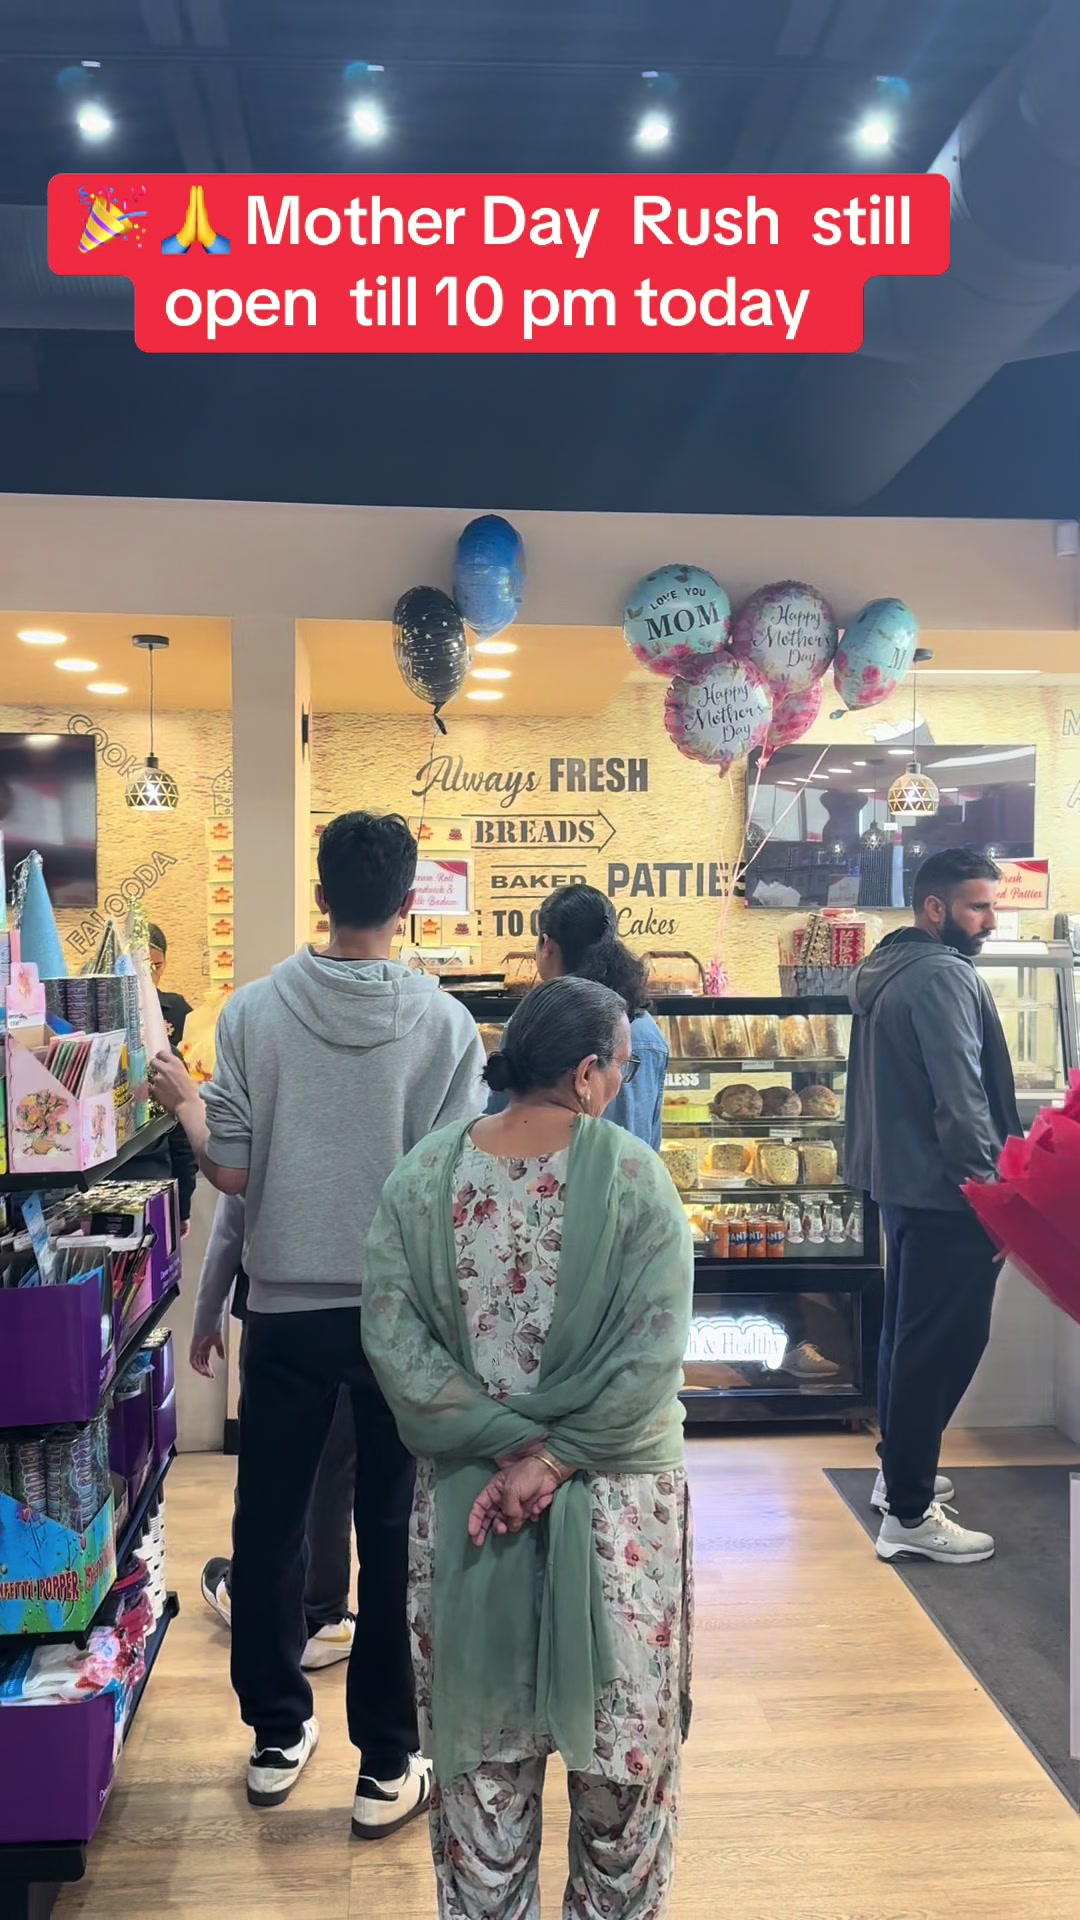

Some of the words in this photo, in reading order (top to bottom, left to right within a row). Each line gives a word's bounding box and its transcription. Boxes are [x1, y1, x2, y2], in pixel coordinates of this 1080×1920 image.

[650, 590, 678, 611] LOVE
[684, 587, 706, 597] YOU
[644, 601, 721, 641] MOM
[770, 603, 822, 631] Happy
[785, 648, 818, 671] Day
[697, 682, 749, 708] Happy
[721, 723, 751, 743] Day
[411, 754, 543, 809] Always
[549, 757, 649, 793] FRESH
[474, 819, 596, 844] BREADS
[490, 873, 588, 890] BAKED
[607, 861, 746, 899] PATTIES
[492, 909, 524, 937] TO
[616, 906, 680, 938] Cakes
[37, 1570, 80, 1602] POPPER
